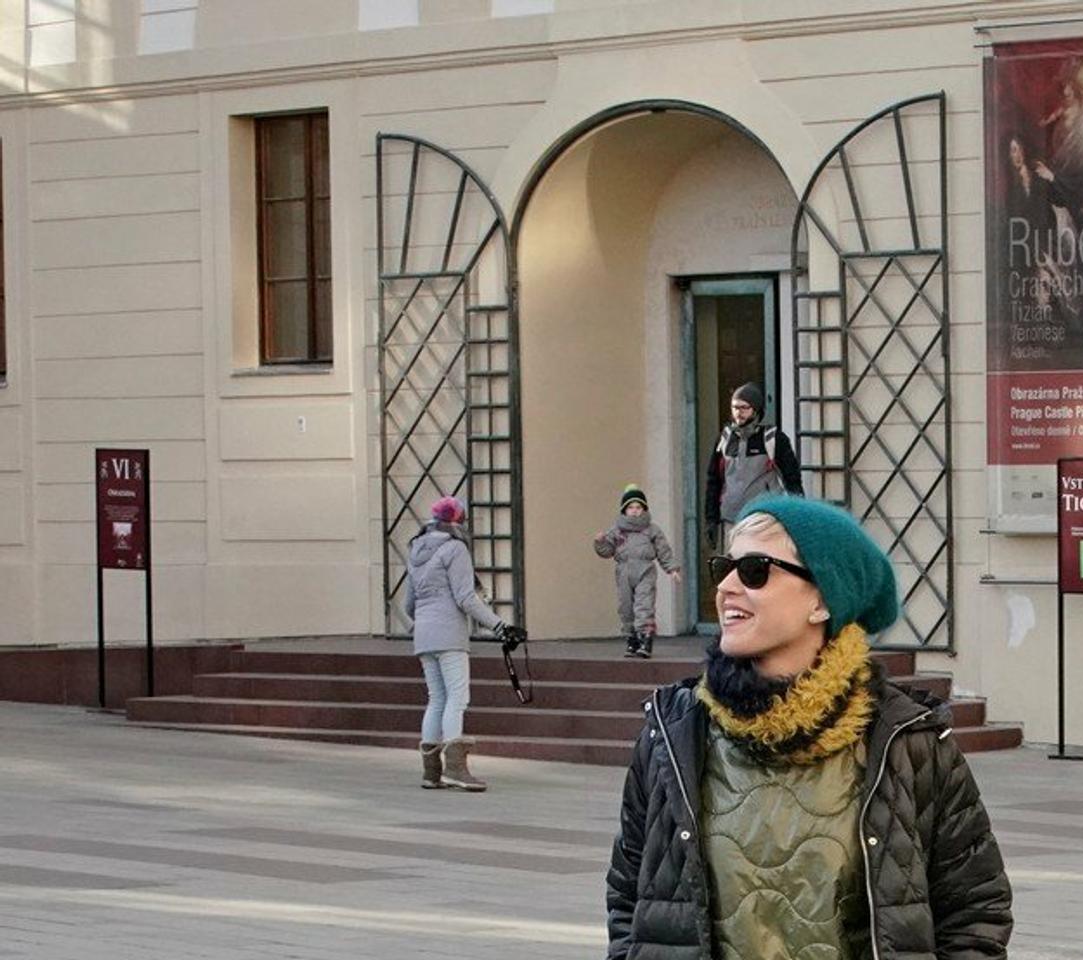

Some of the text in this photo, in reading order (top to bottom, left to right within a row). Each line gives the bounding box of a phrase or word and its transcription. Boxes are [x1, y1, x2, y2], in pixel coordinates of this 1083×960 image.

[1010, 406, 1042, 421] Prague
[1044, 405, 1073, 419] Castle
[112, 458, 130, 480] VI
